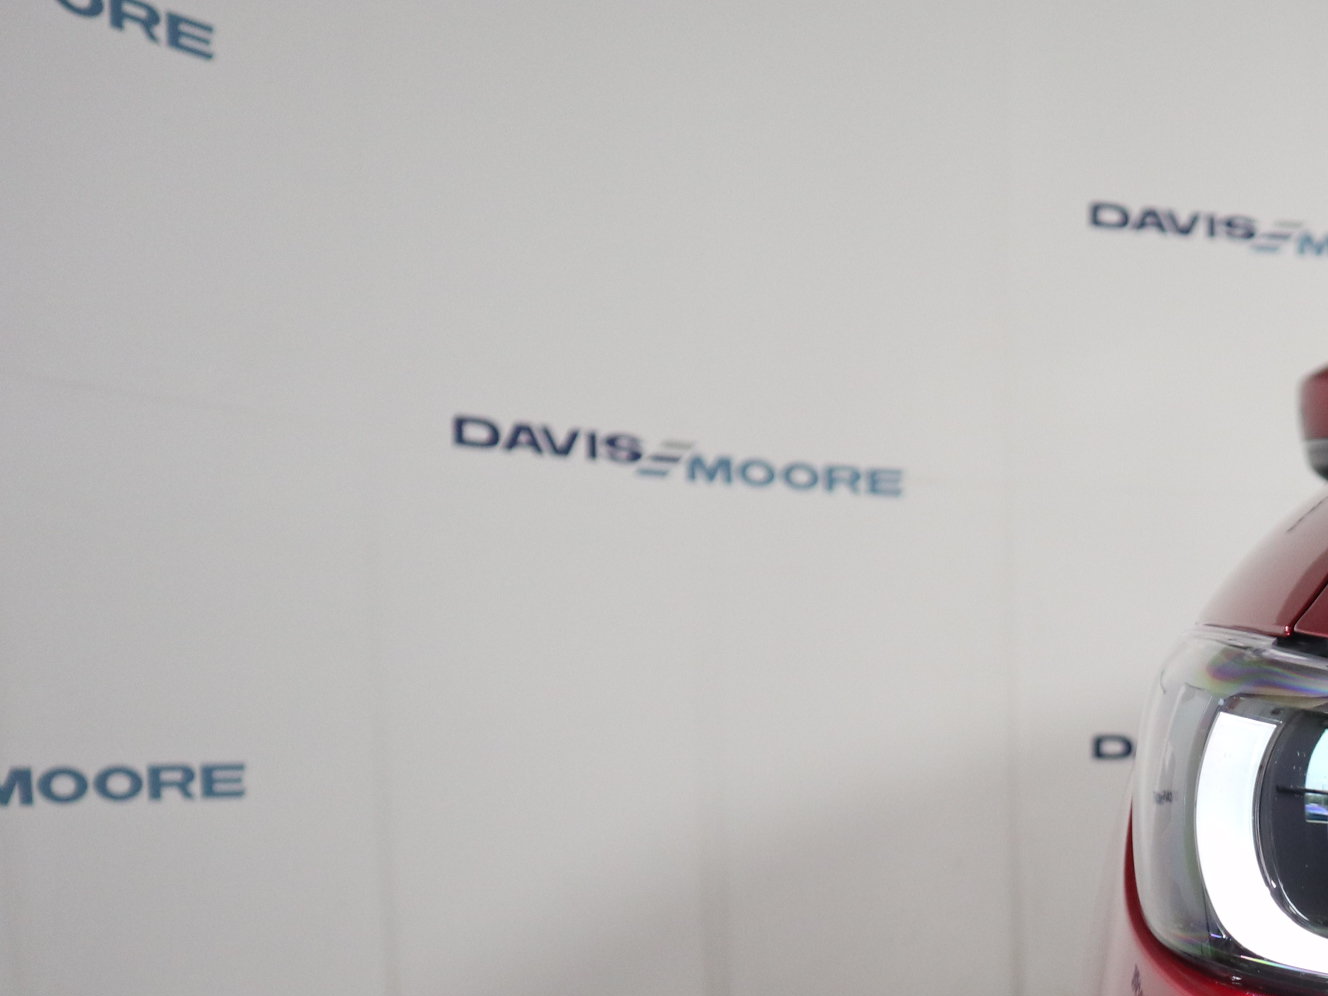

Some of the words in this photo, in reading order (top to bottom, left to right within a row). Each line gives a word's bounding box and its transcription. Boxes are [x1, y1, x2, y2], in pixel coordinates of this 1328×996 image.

[1089, 201, 1257, 241] DAVIS
[453, 415, 644, 463] DAVIS
[687, 454, 904, 496] MOORE
